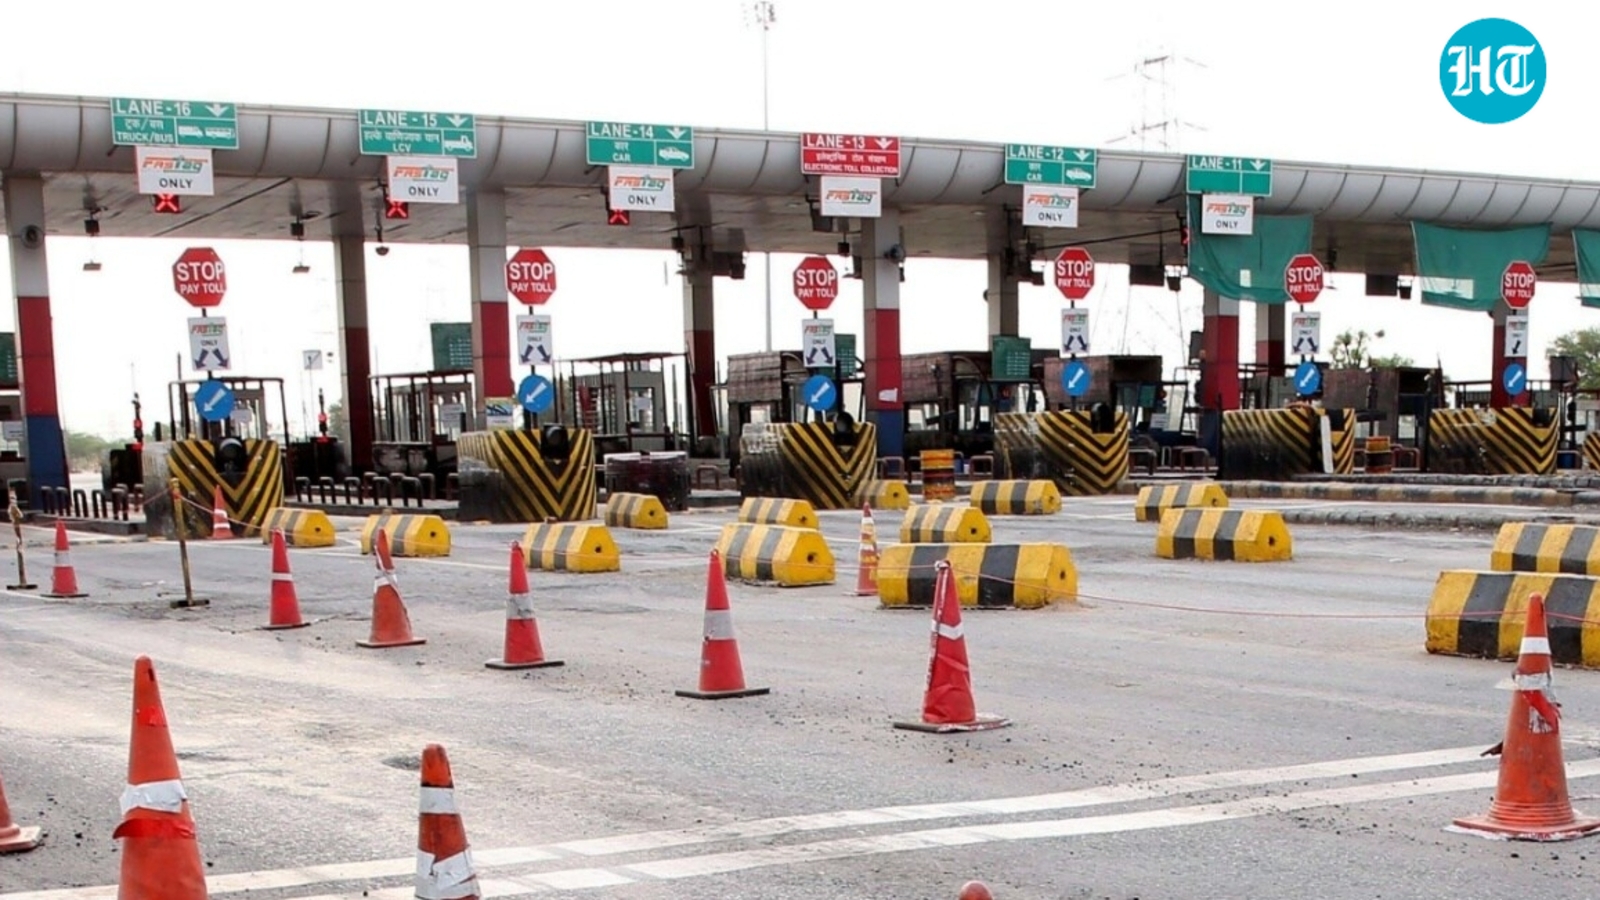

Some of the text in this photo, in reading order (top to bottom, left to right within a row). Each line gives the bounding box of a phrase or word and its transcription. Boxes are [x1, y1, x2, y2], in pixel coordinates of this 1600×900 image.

[392, 143, 411, 153] LCV
[612, 153, 631, 162] CAR
[844, 164, 859, 173] TOLL
[1026, 173, 1042, 182] CAR
[159, 178, 193, 189] ONLY
[408, 186, 438, 196] ONLY
[628, 195, 656, 205] ONLY
[1038, 212, 1062, 221] ONLY
[1216, 221, 1238, 229] ONLY
[176, 262, 224, 281] STOP
[509, 262, 553, 280] STOP
[1057, 260, 1092, 277] STOP
[796, 269, 836, 286] STOP
[1288, 267, 1320, 283] STOP
[1058, 278, 1091, 288] PAY TOLL
[1505, 273, 1534, 288] STOP
[180, 283, 225, 294] PAY TOLL
[511, 283, 552, 292] PAY TOLL
[1290, 284, 1319, 293] PAY TOLL
[798, 288, 834, 298] PAY TOLL
[1505, 289, 1532, 297] PAY TOLL
